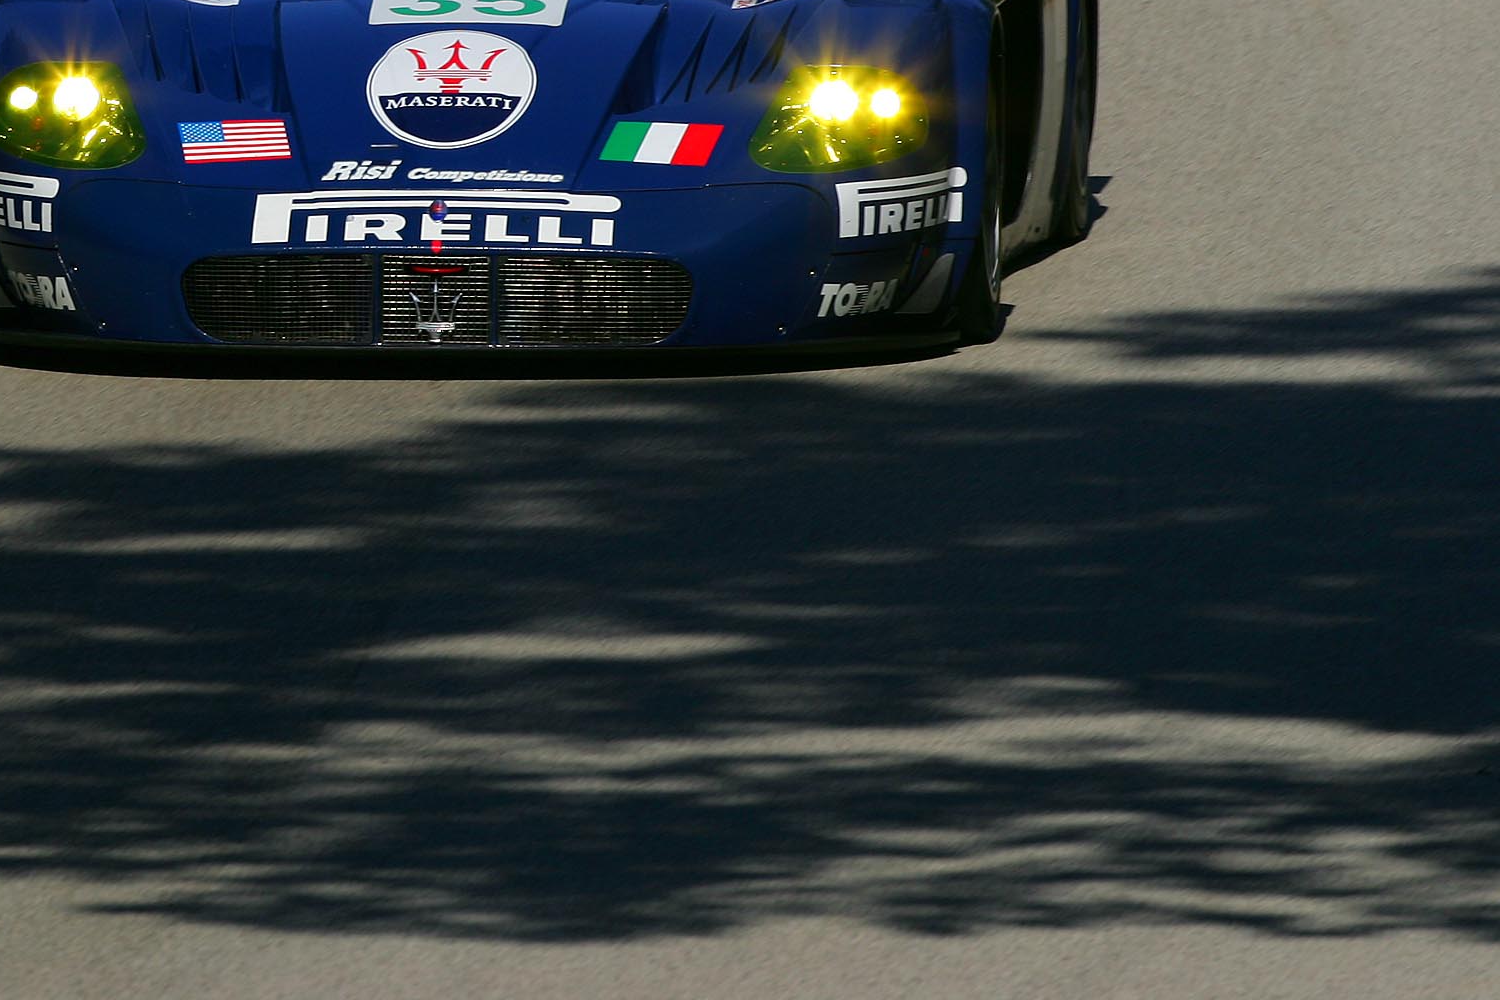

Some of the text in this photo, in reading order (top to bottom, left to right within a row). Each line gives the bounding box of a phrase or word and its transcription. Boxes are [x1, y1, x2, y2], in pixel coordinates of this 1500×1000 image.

[385, 95, 512, 110] MASERATI
[321, 160, 564, 183] Risi Competizione
[251, 189, 622, 246] PIRELLI
[835, 166, 968, 239] PIRELLI
